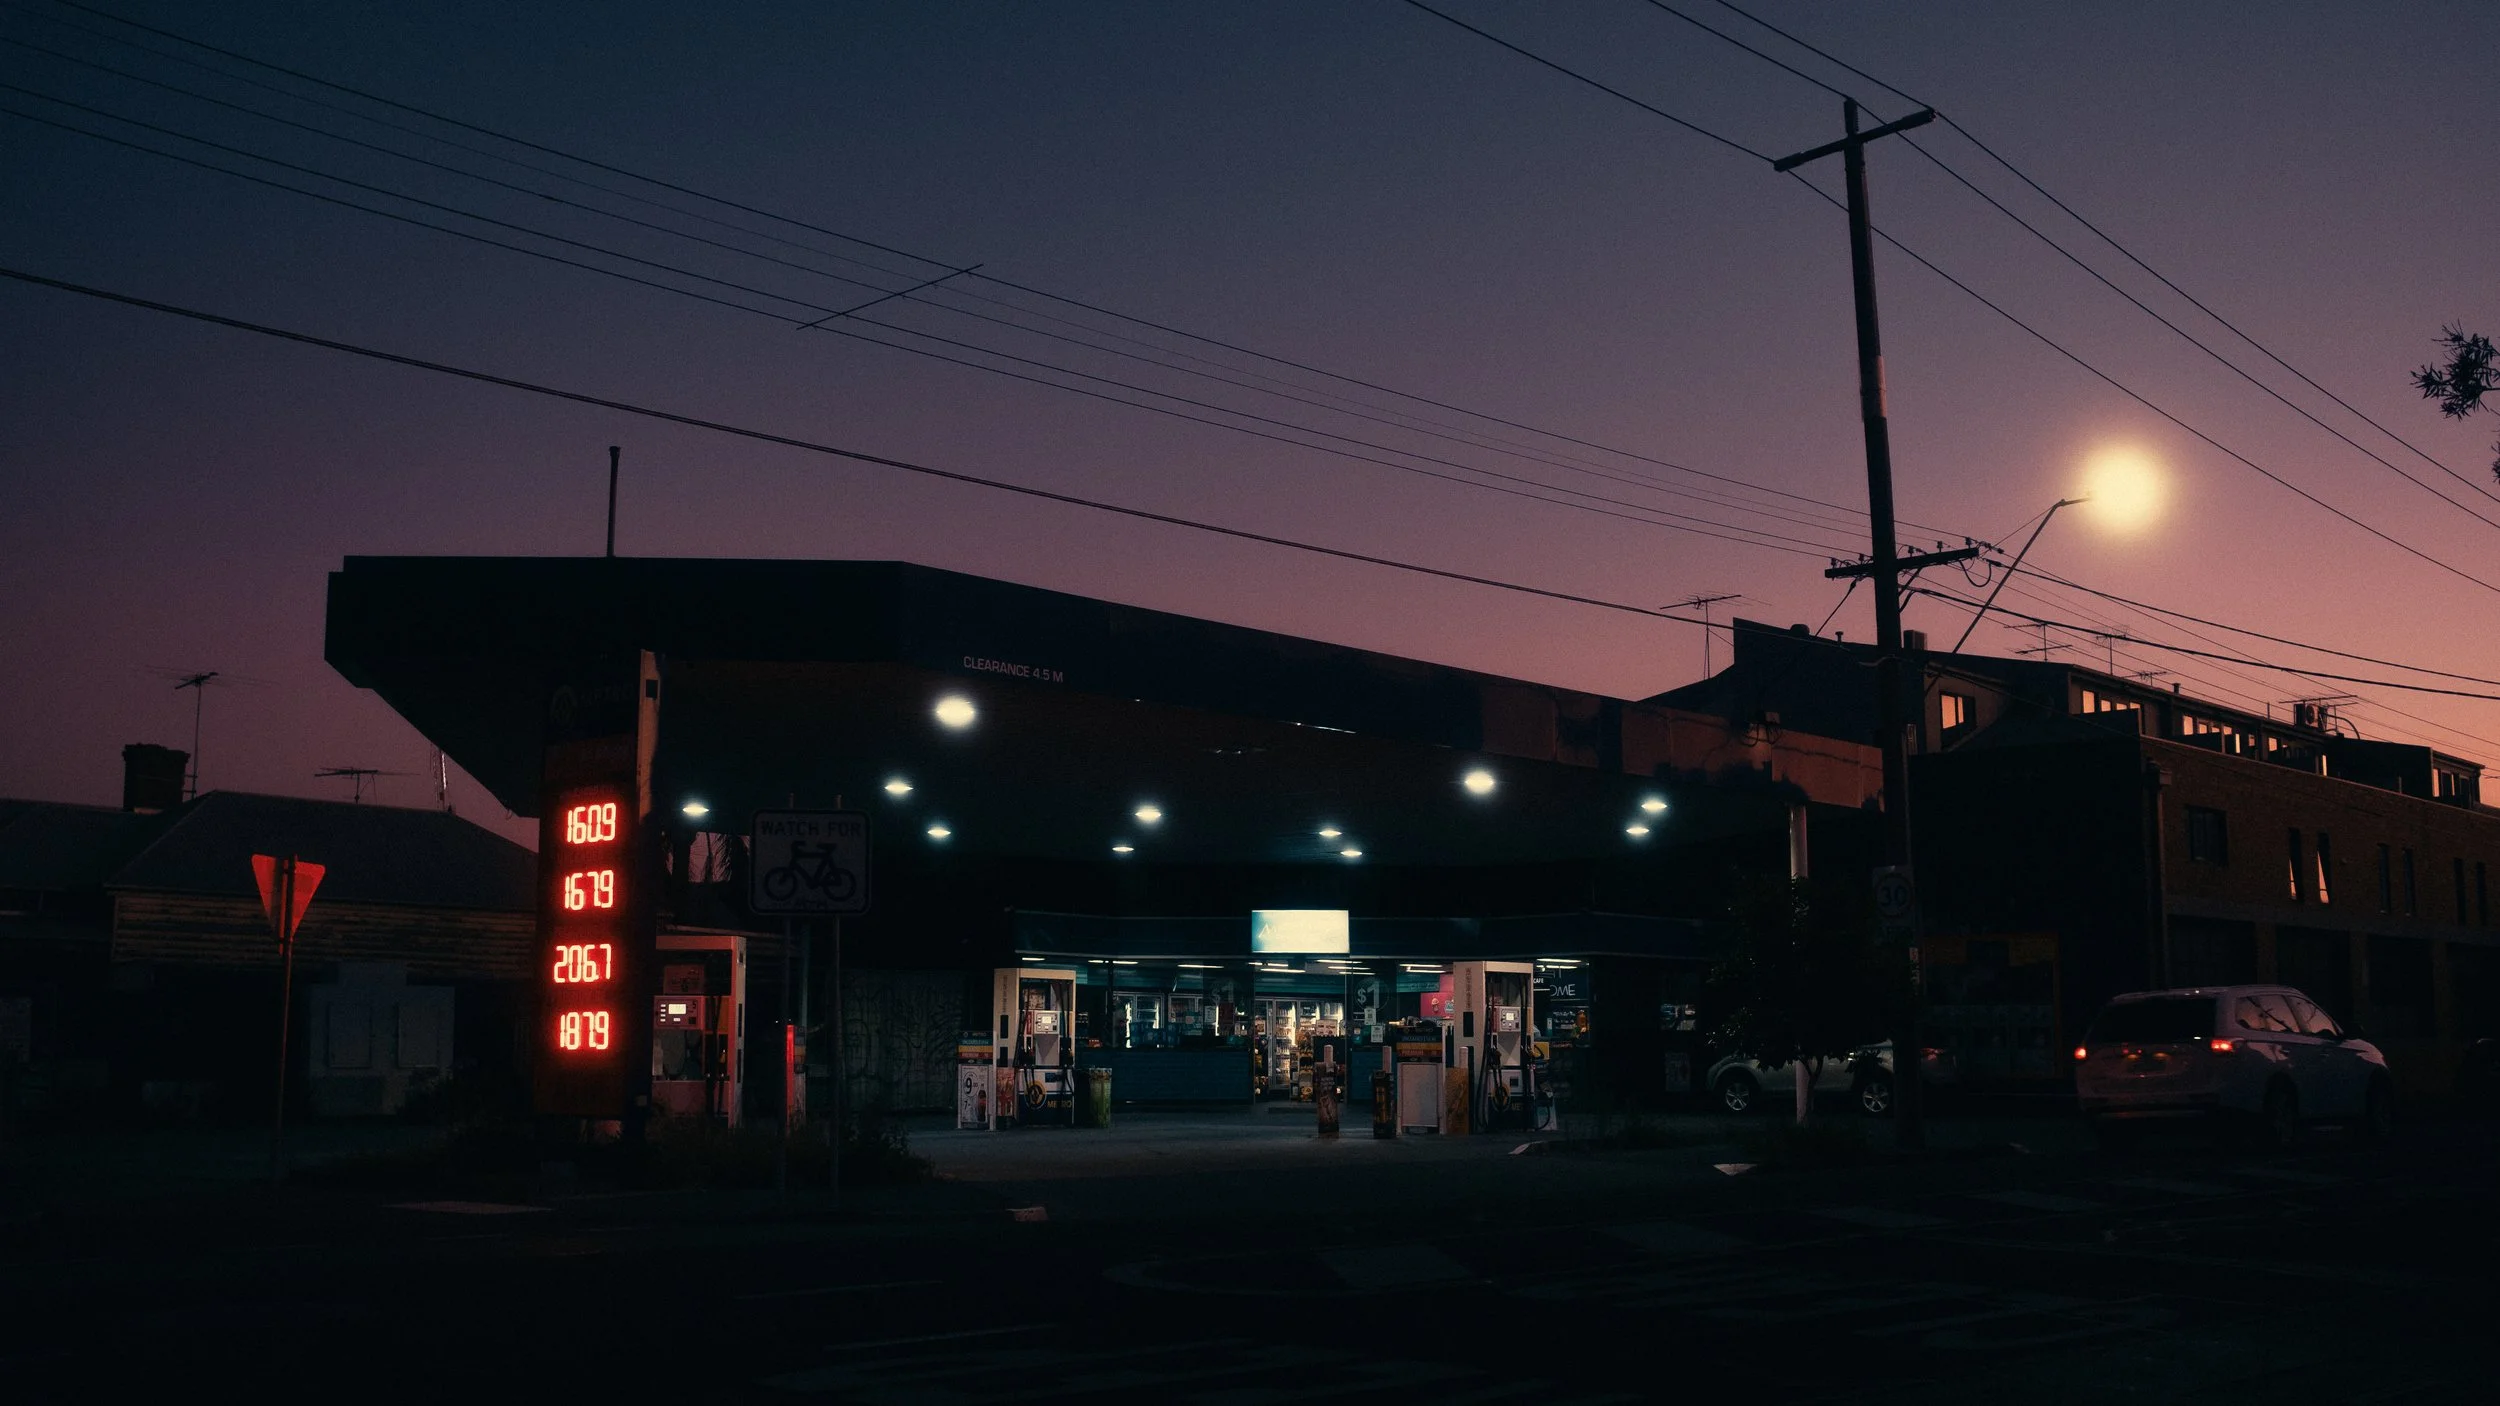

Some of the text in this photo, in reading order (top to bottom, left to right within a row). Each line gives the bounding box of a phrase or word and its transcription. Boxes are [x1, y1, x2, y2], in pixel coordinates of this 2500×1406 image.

[963, 656, 1064, 683] CLEARANCE 4.5 M
[761, 820, 862, 837] WATCH FOR
[1880, 885, 1907, 906] 30
[1357, 980, 1380, 1009] $1
